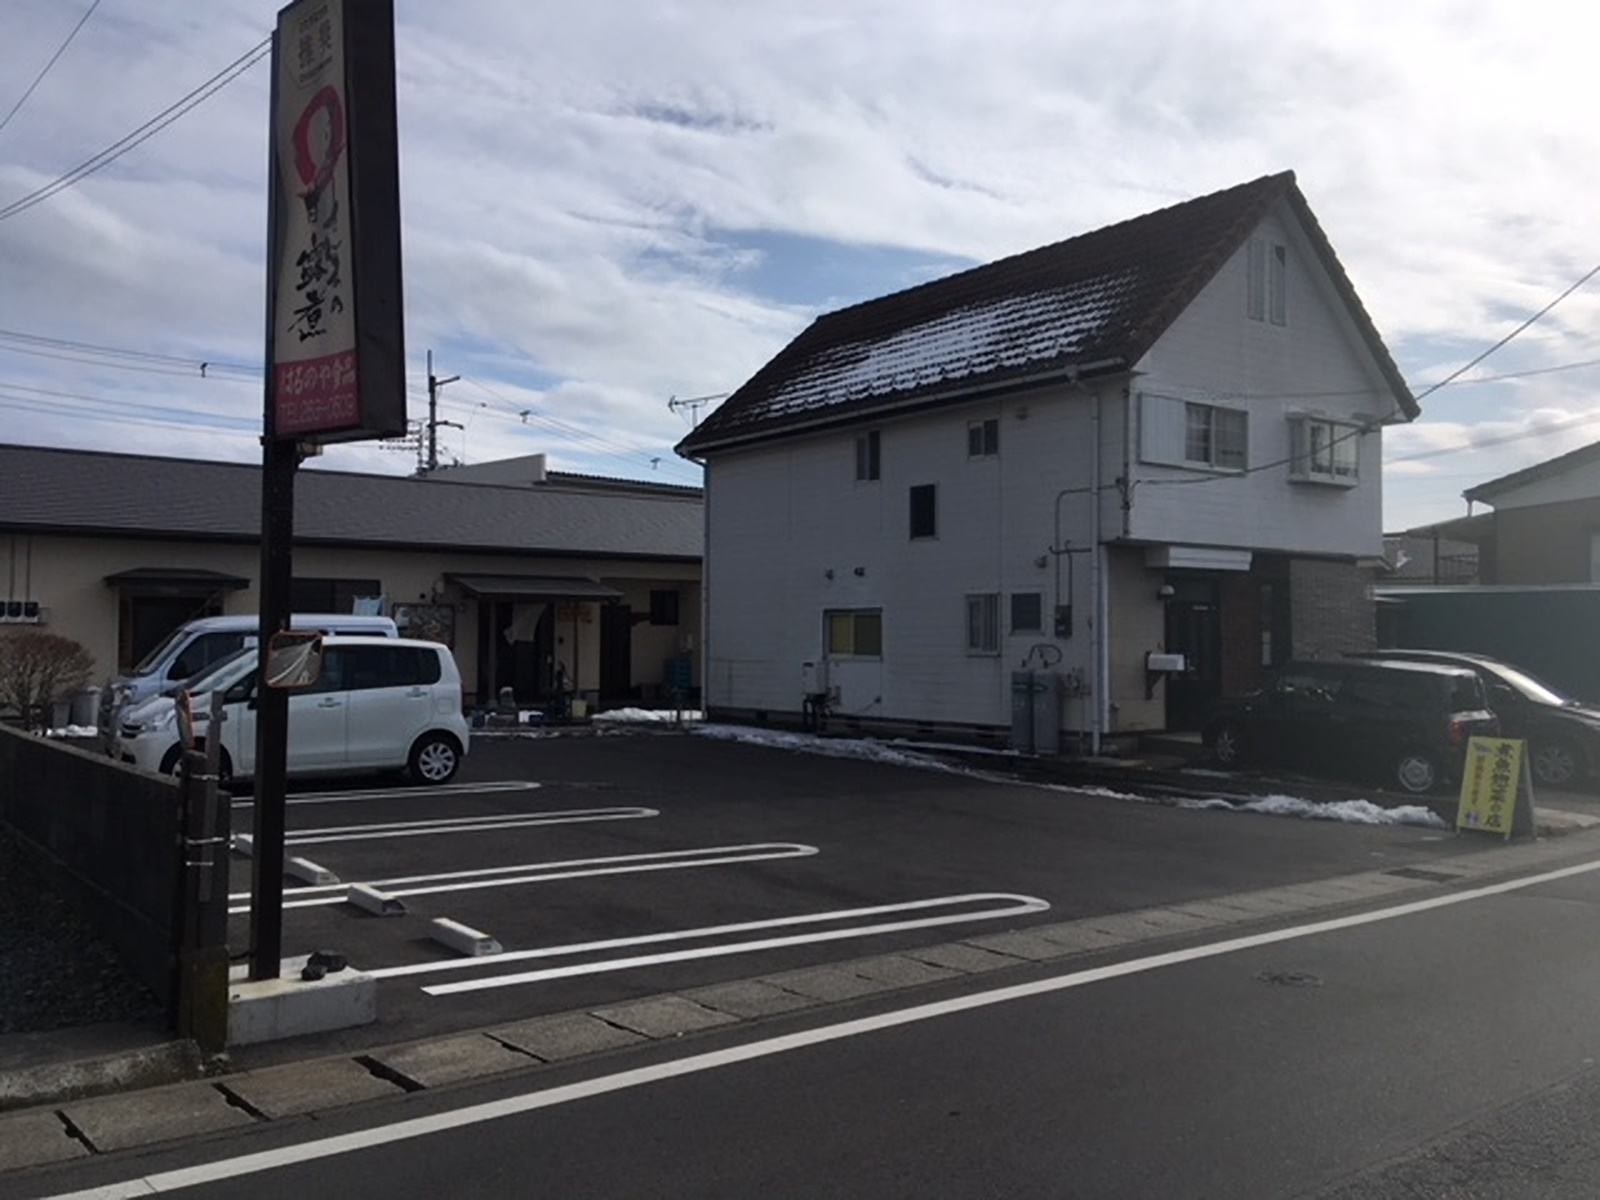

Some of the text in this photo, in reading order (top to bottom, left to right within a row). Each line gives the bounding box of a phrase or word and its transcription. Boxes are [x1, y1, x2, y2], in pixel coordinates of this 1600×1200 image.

[280, 356, 356, 395] はるのや食品
